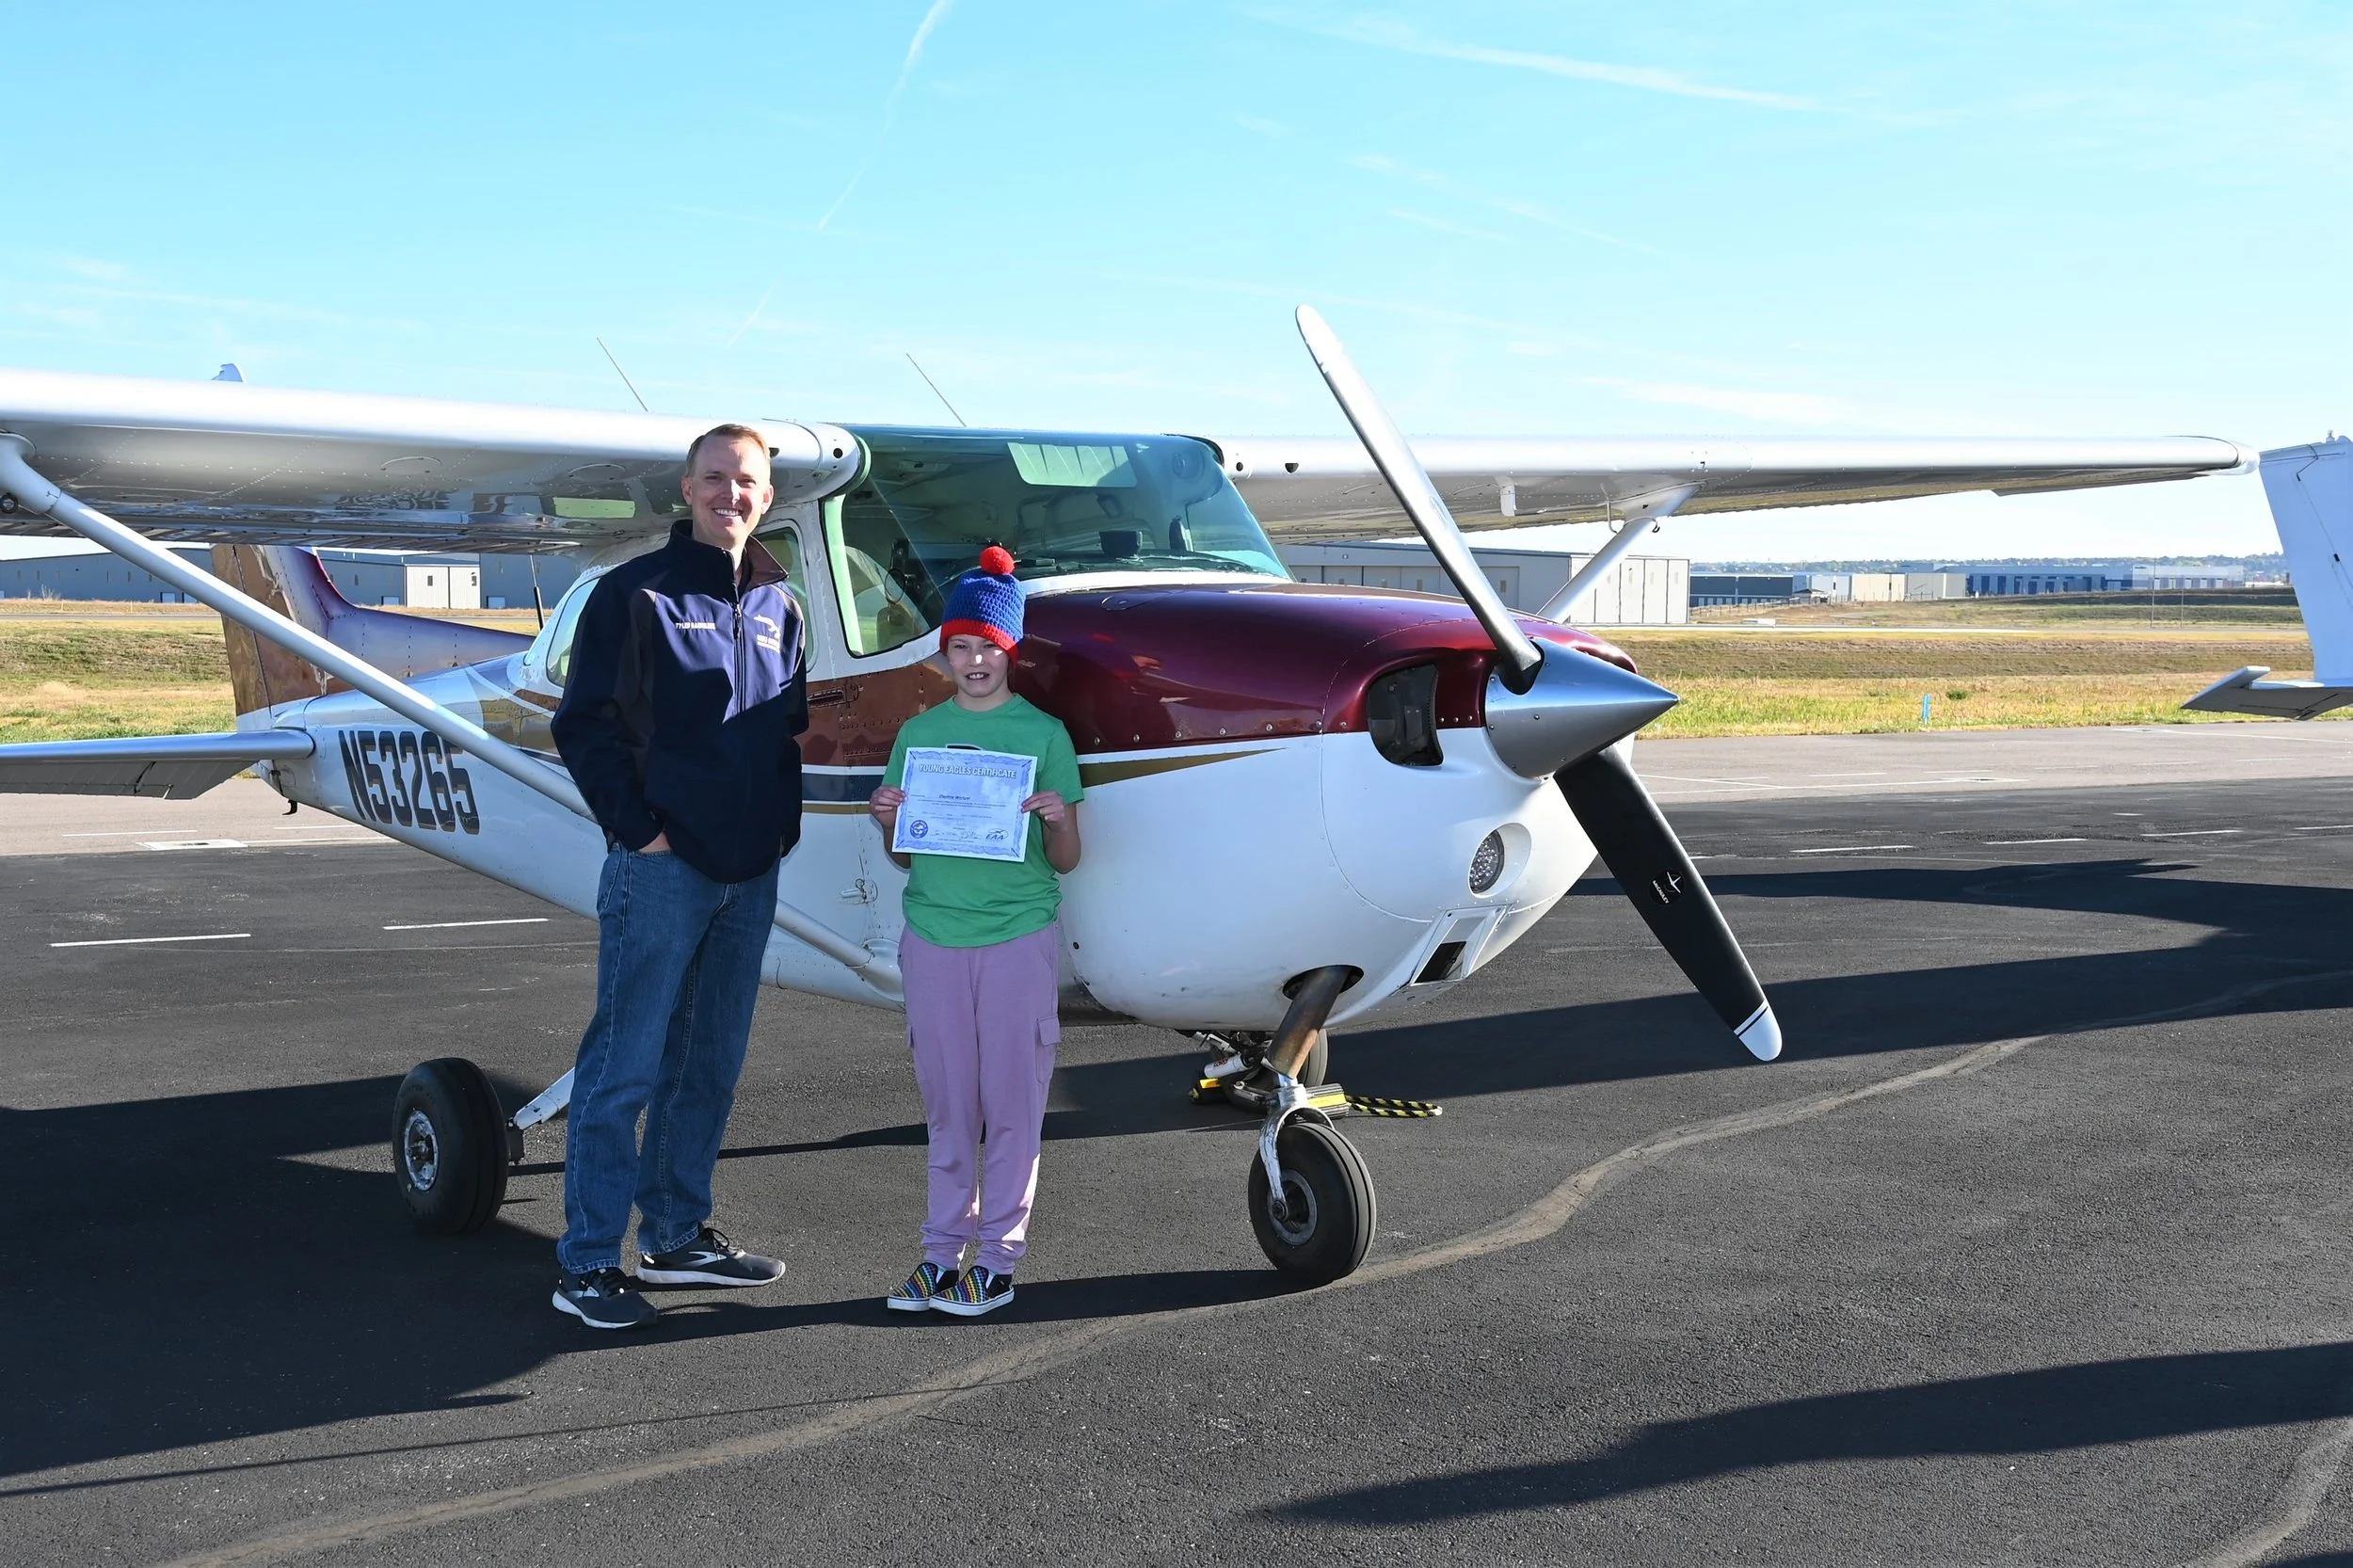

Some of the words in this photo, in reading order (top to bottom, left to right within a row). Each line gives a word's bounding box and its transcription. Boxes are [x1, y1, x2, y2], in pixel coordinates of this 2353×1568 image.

[338, 729, 480, 836] N53265
[919, 763, 943, 774] YOUNG
[945, 766, 972, 776] EAGLES
[972, 767, 1016, 779] CERTIFICATE
